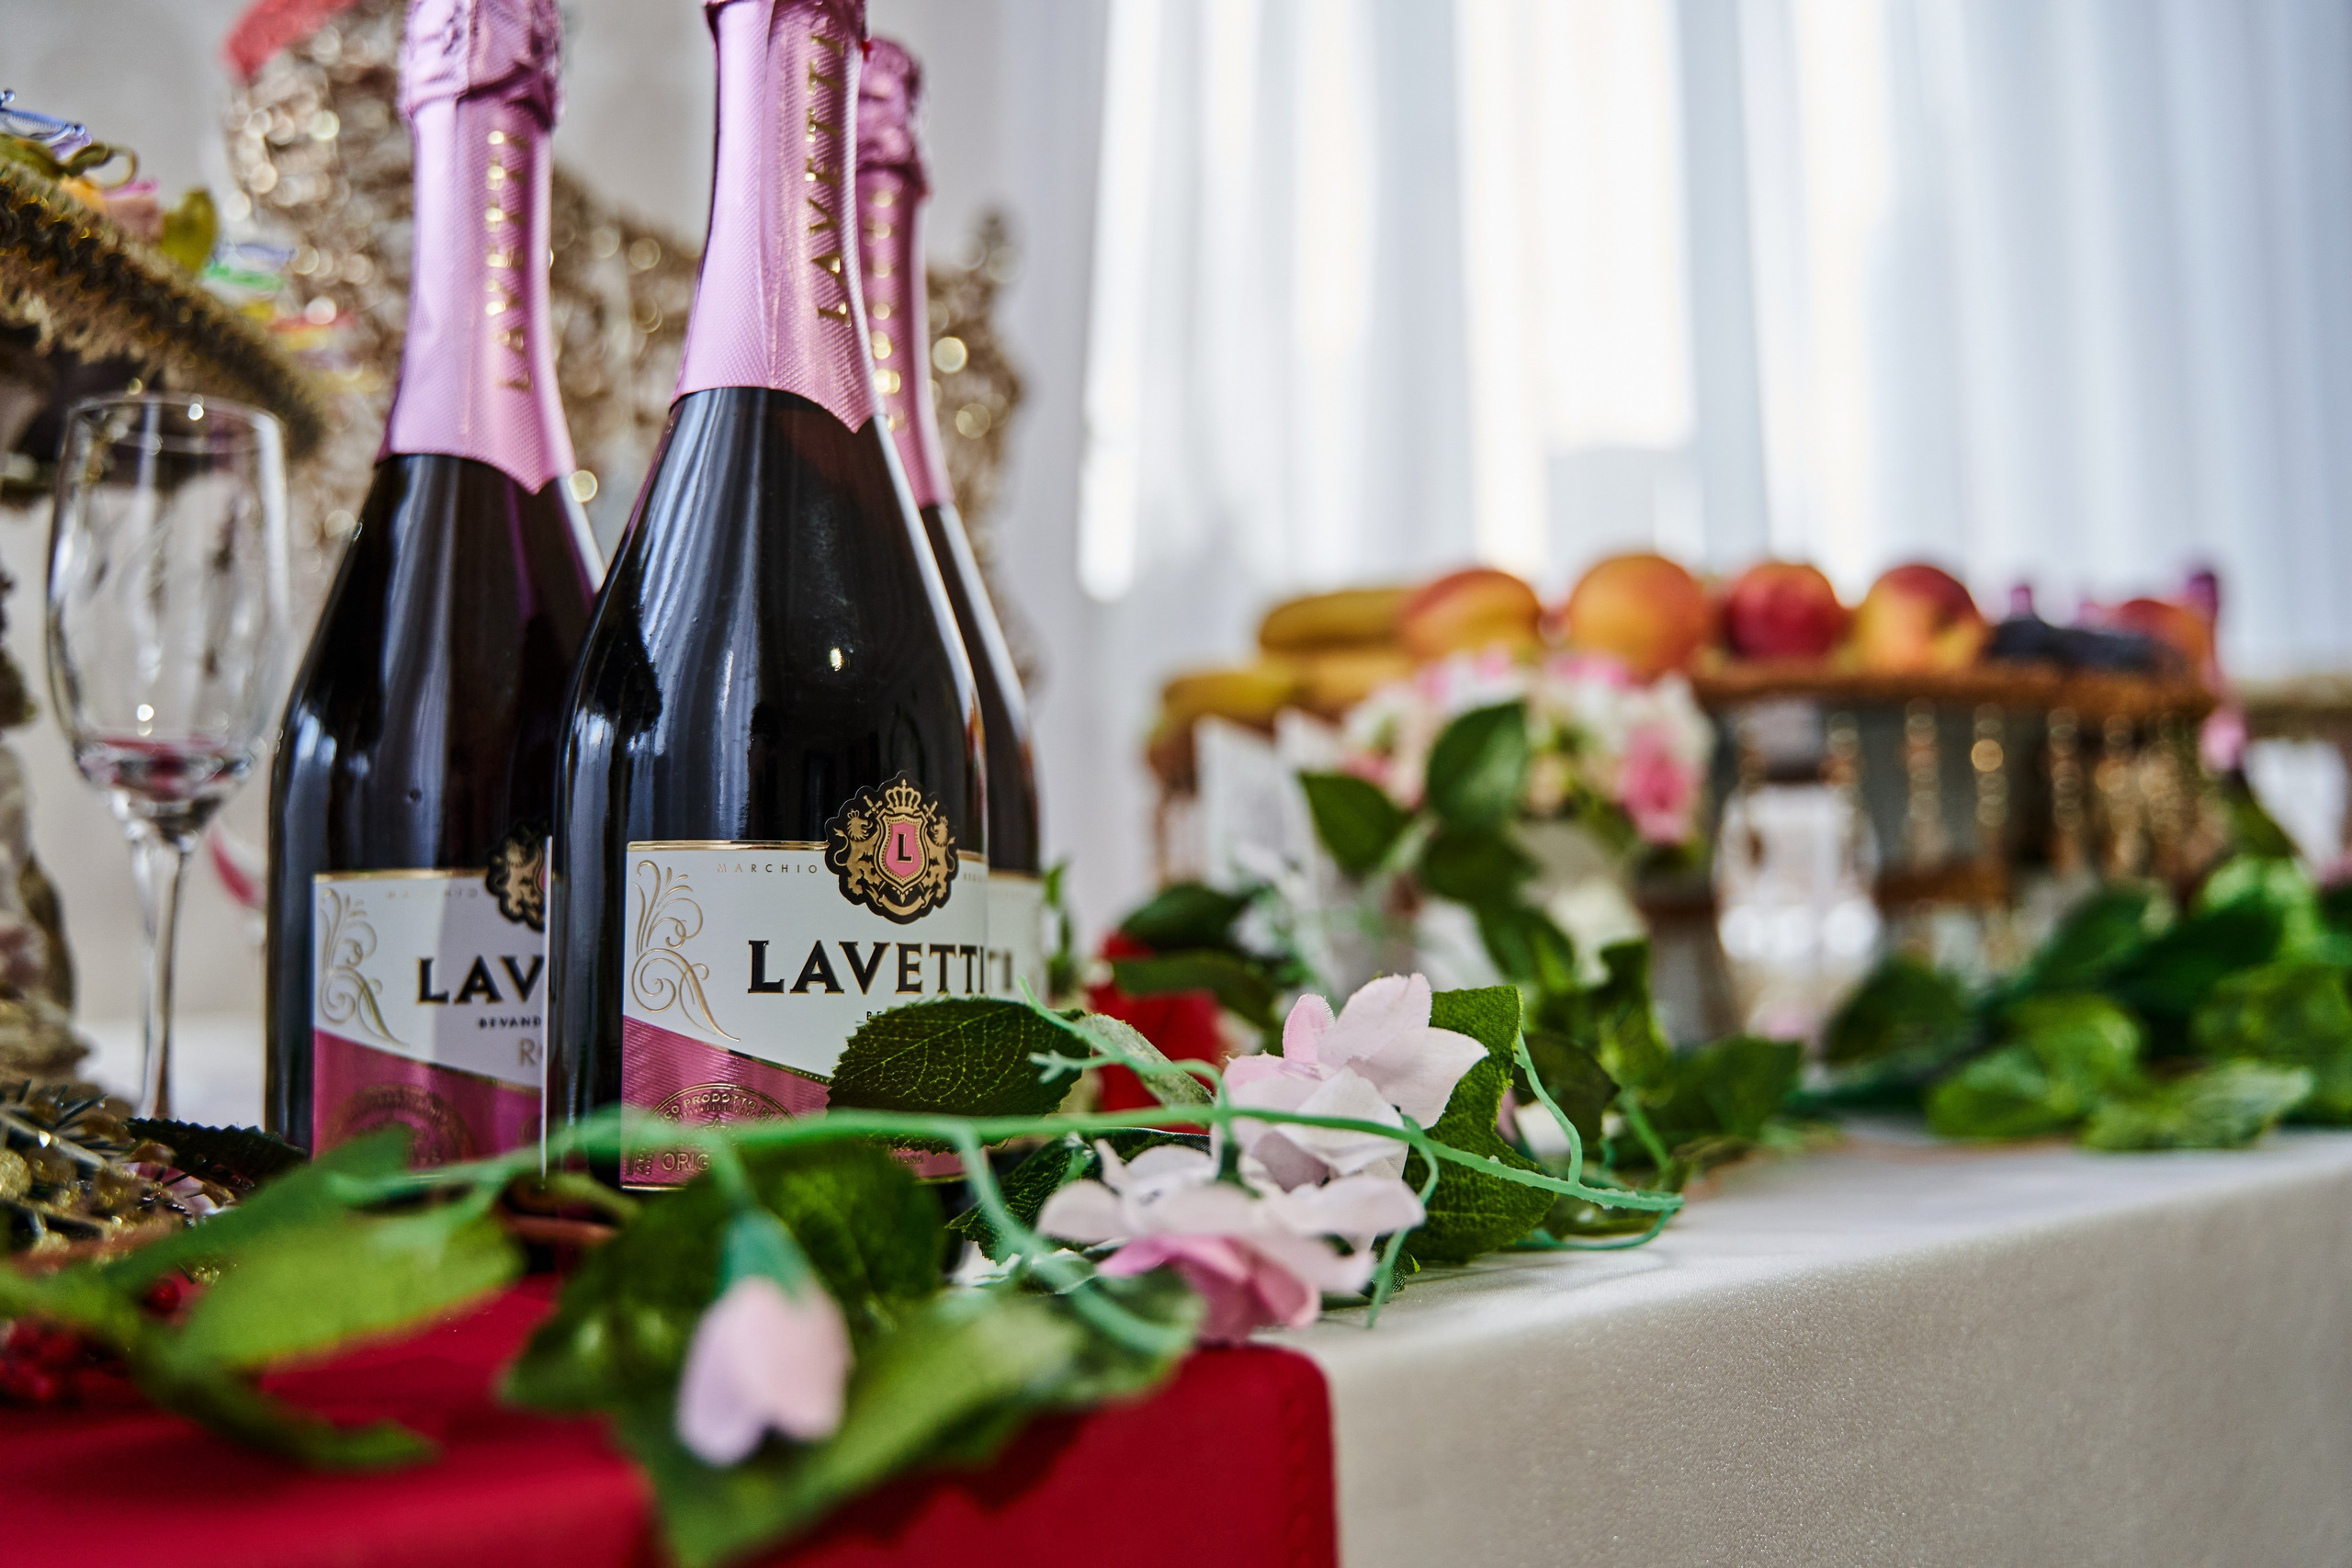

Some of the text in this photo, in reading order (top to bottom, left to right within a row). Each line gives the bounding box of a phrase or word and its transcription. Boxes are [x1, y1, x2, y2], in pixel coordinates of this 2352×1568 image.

[897, 832, 913, 863] L
[717, 863, 818, 874] MARCHIO
[478, 1017, 542, 1029] BEVAND
[683, 1092, 758, 1111] PRODOTTO
